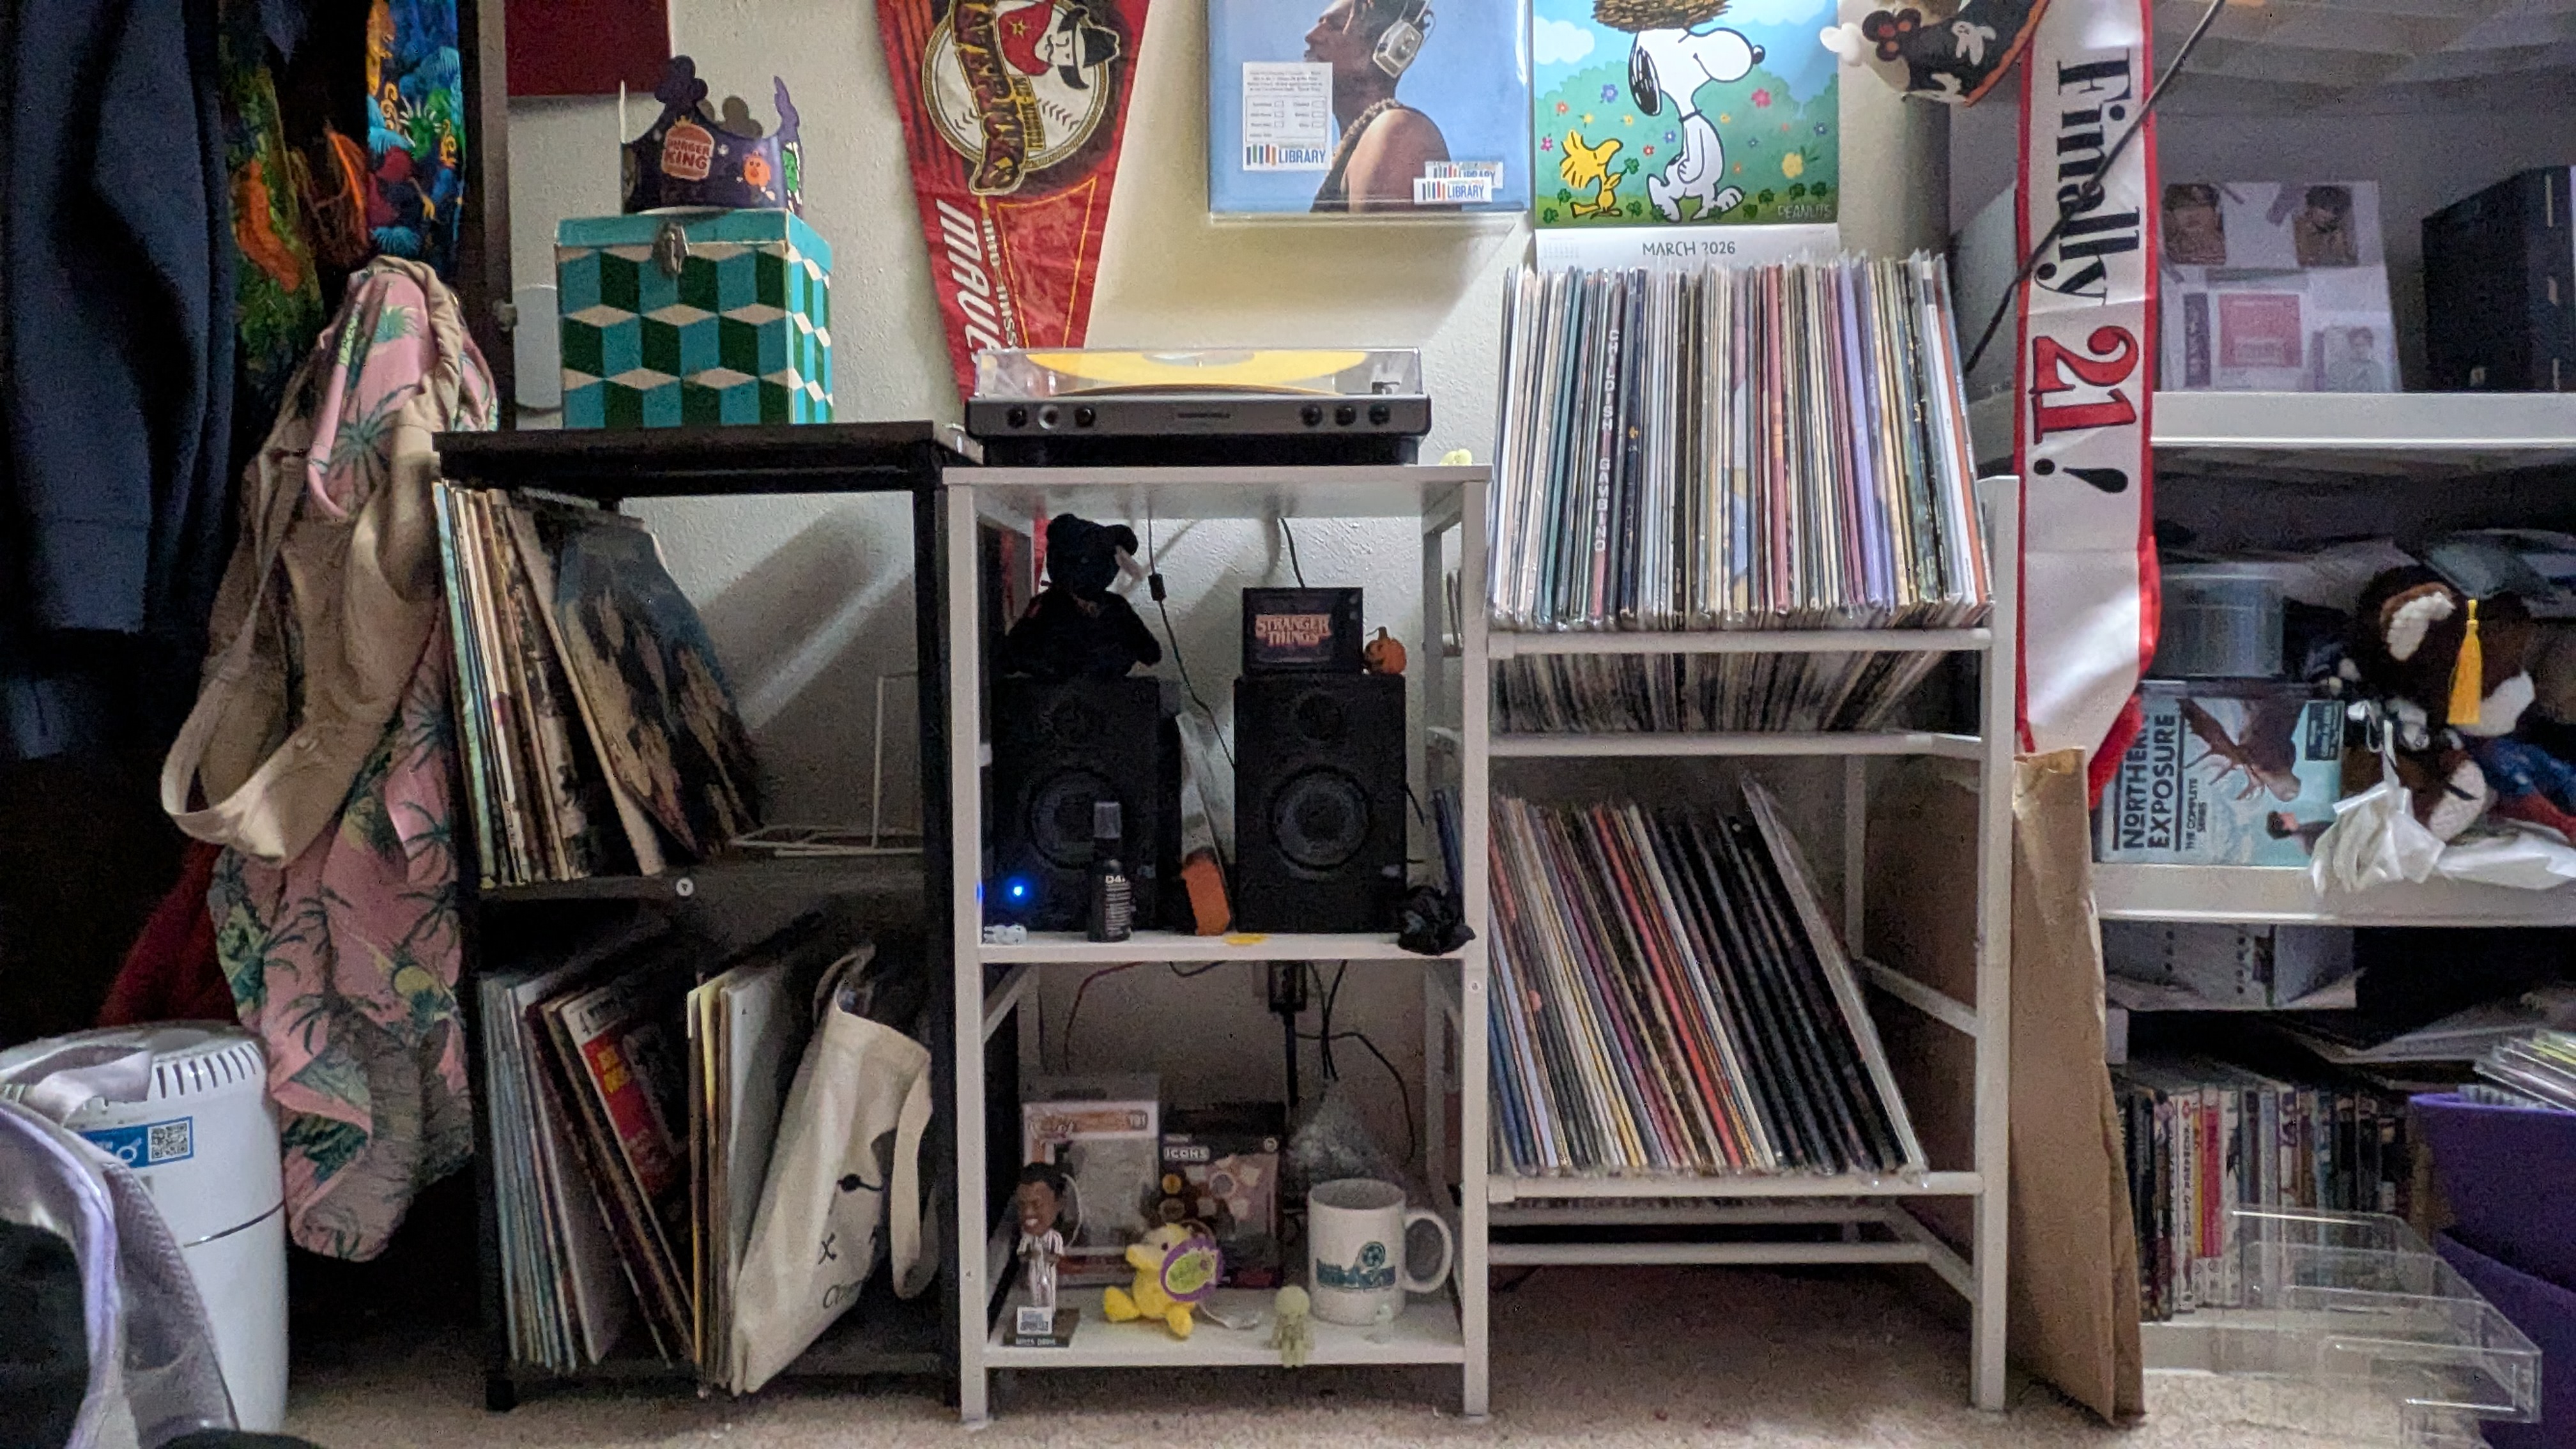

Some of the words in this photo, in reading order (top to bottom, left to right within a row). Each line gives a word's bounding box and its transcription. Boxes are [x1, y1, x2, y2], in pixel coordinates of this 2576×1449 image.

[954, 0, 1025, 190] AVERICKS
[667, 140, 709, 157] BURGER
[1278, 148, 1326, 164] LIBRARY
[664, 150, 707, 170] KING
[2034, 48, 2140, 305] Finally
[1447, 184, 1484, 199] LIBRARY
[1778, 204, 1832, 218] PEANUTS
[1643, 241, 1696, 256] MARCH
[1702, 241, 1735, 254] 2026
[1601, 330, 1619, 431] CHILDISH
[1595, 457, 1610, 552] GAMBINO
[1255, 615, 1331, 638] STRANGER
[1269, 631, 1320, 647] THINGS
[2122, 715, 2149, 848] NORTHER
[2147, 714, 2175, 848] EXPOSURE
